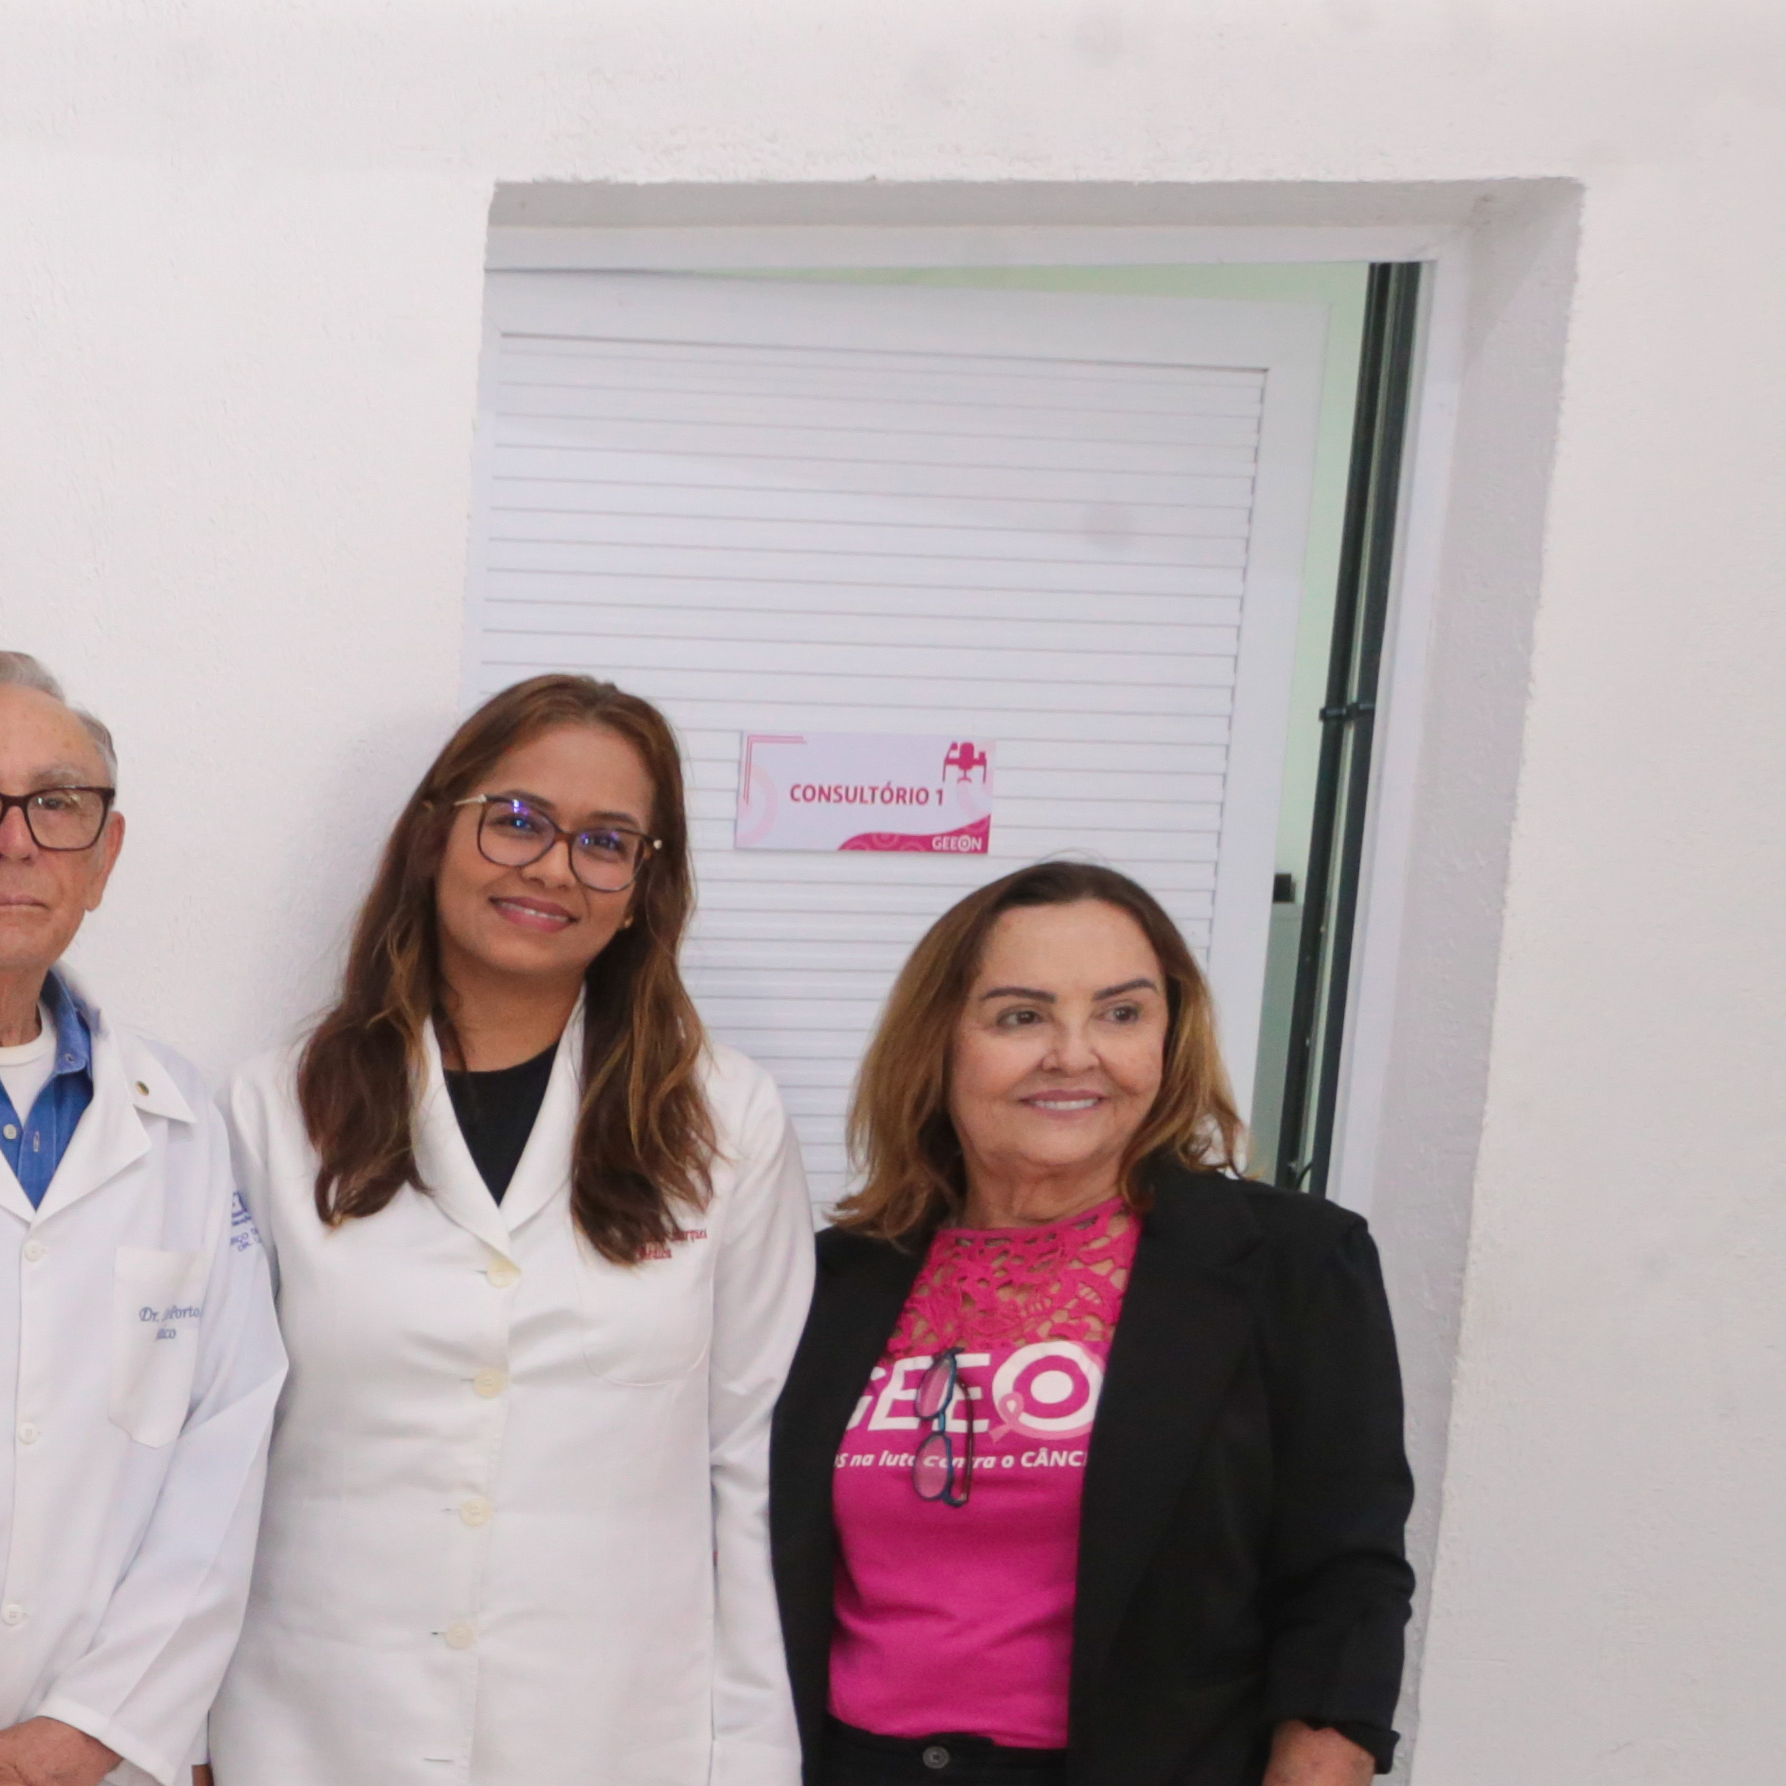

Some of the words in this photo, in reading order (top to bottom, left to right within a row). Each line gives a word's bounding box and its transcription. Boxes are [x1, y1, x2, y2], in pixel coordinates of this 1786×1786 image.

[789, 780, 930, 806] CONSULTÓRIO
[935, 788, 945, 807] 1
[931, 834, 983, 852] GEEON
[849, 1452, 875, 1468] na
[1001, 1454, 1015, 1469] o
